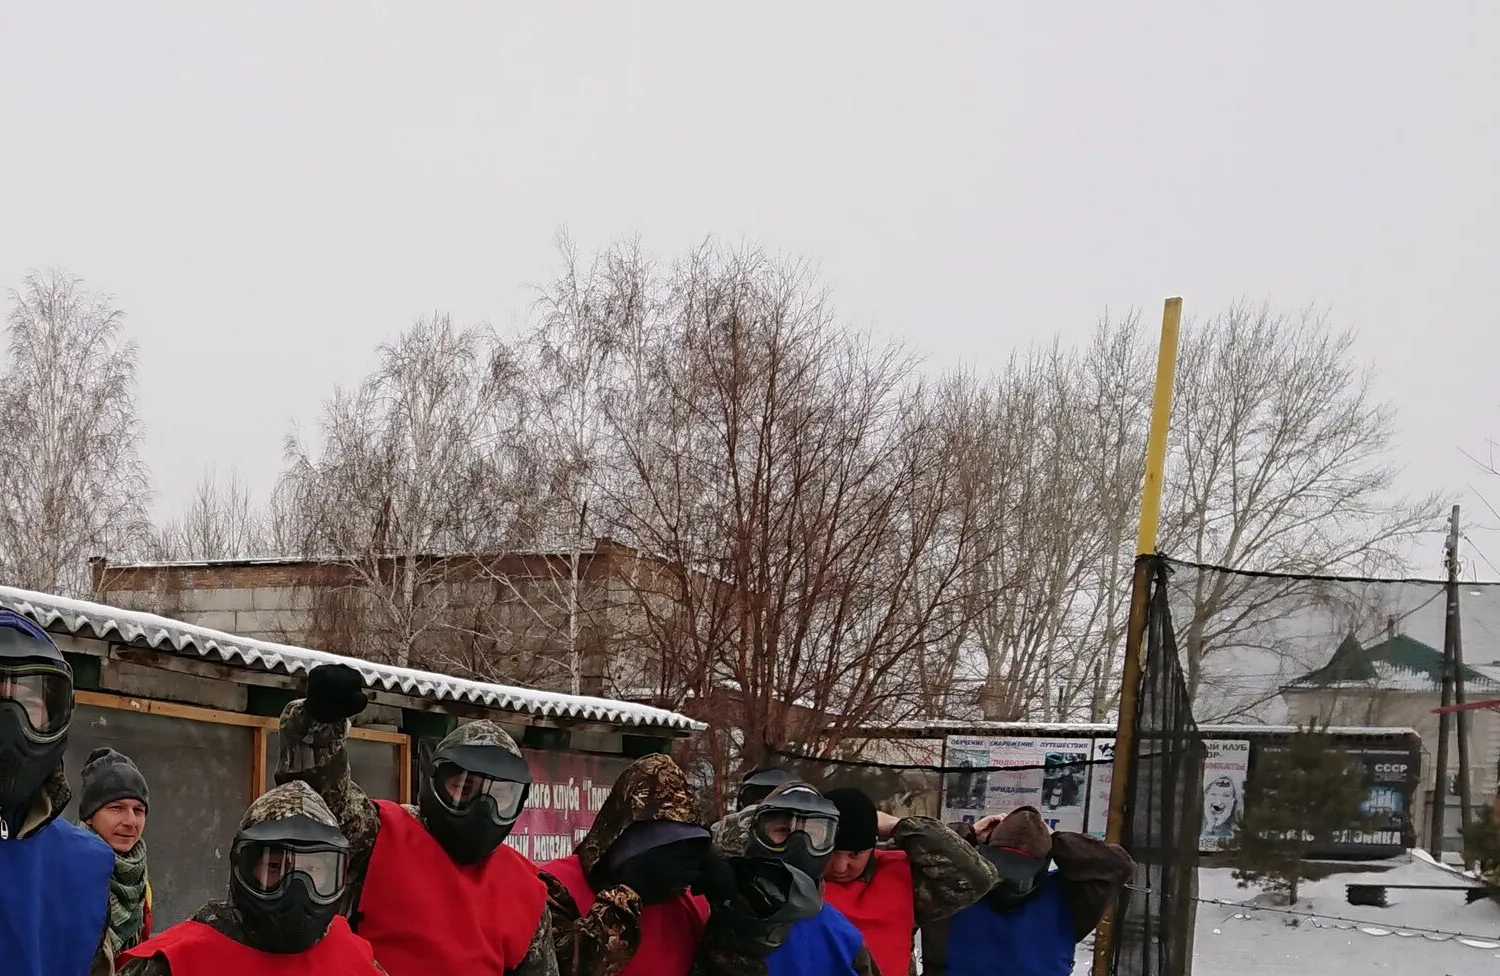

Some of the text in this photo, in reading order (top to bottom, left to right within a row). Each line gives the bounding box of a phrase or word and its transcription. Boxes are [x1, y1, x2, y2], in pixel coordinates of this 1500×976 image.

[989, 740, 1035, 748] СНАРЯЖЕНИЕ
[1222, 743, 1247, 751] КЛУБ
[1374, 764, 1408, 773] СССР
[553, 777, 580, 820] клуба
[534, 835, 572, 861] магазин
